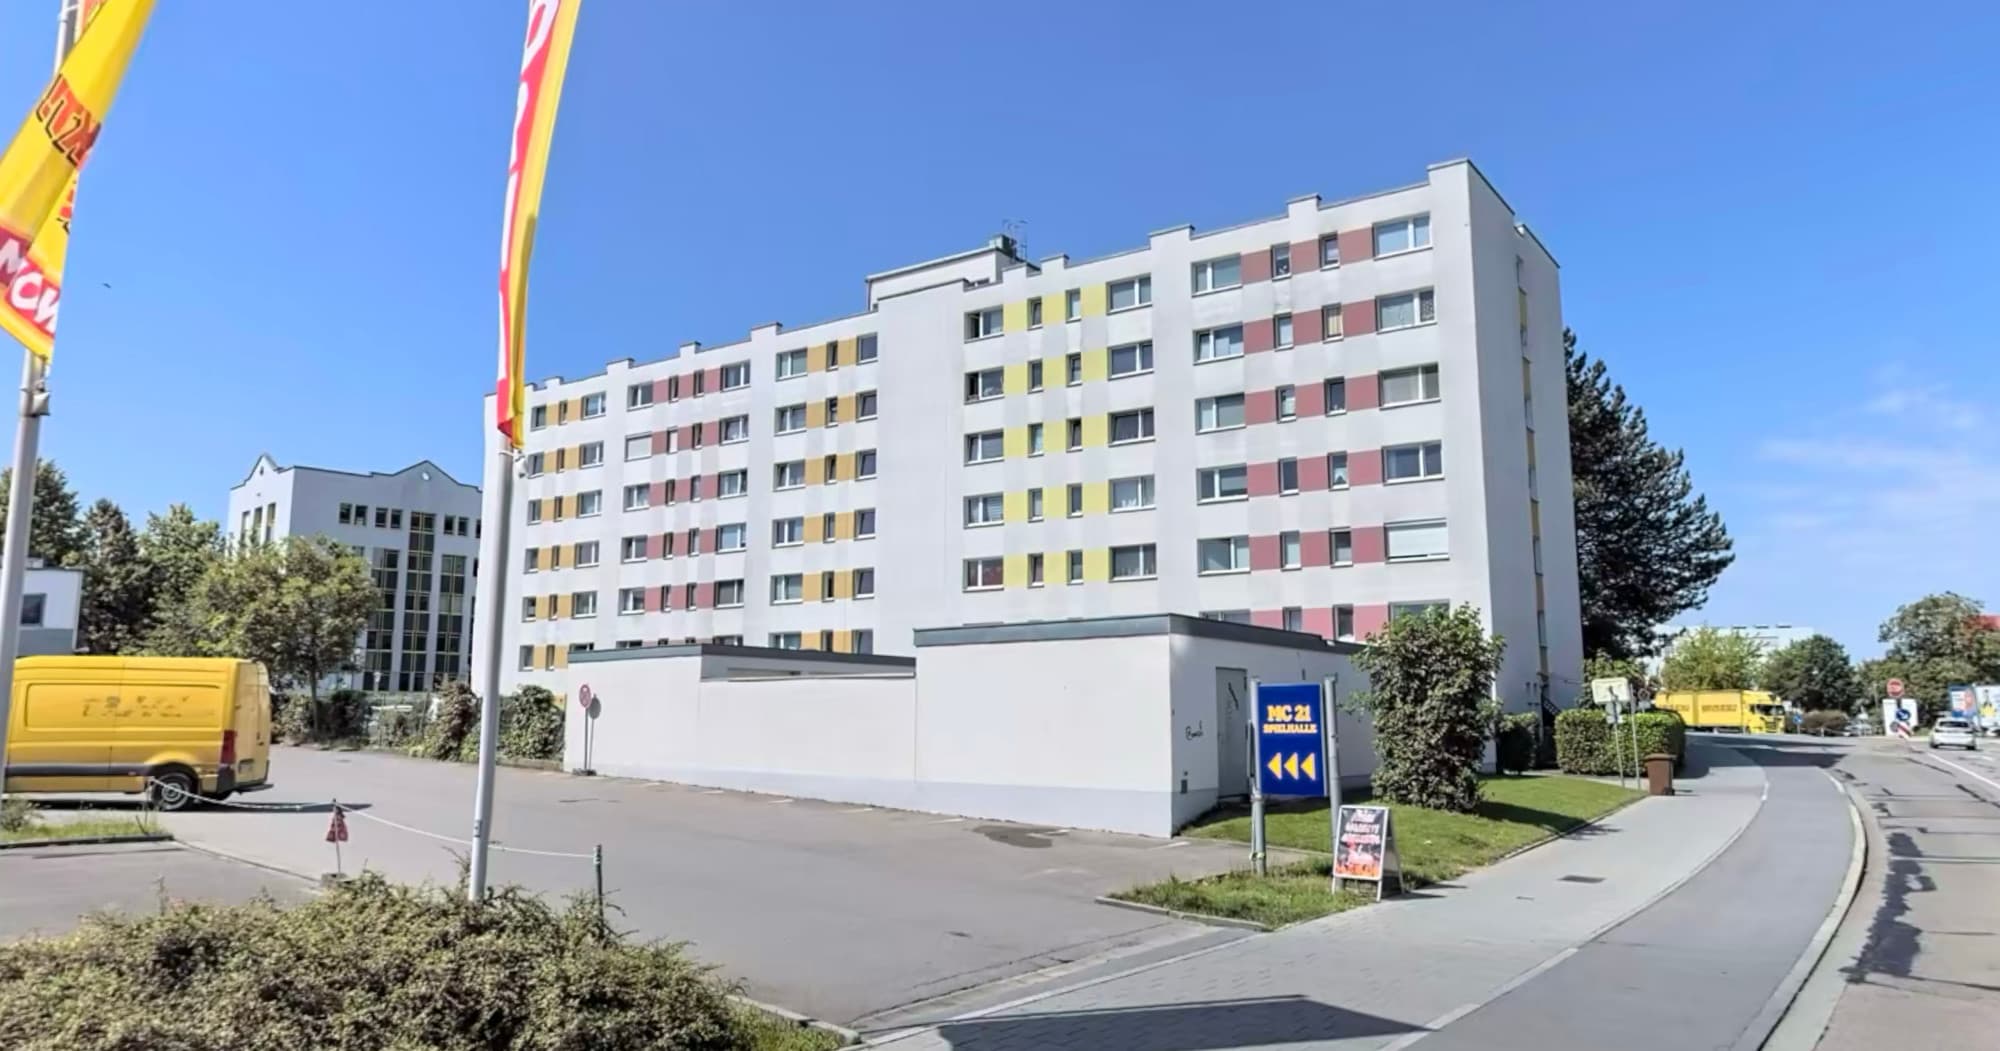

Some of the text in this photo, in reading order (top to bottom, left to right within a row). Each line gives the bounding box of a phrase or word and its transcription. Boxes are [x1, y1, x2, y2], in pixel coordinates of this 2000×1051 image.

[1267, 704, 1312, 722] MC 21
[1263, 723, 1318, 734] SPIELHALLE
